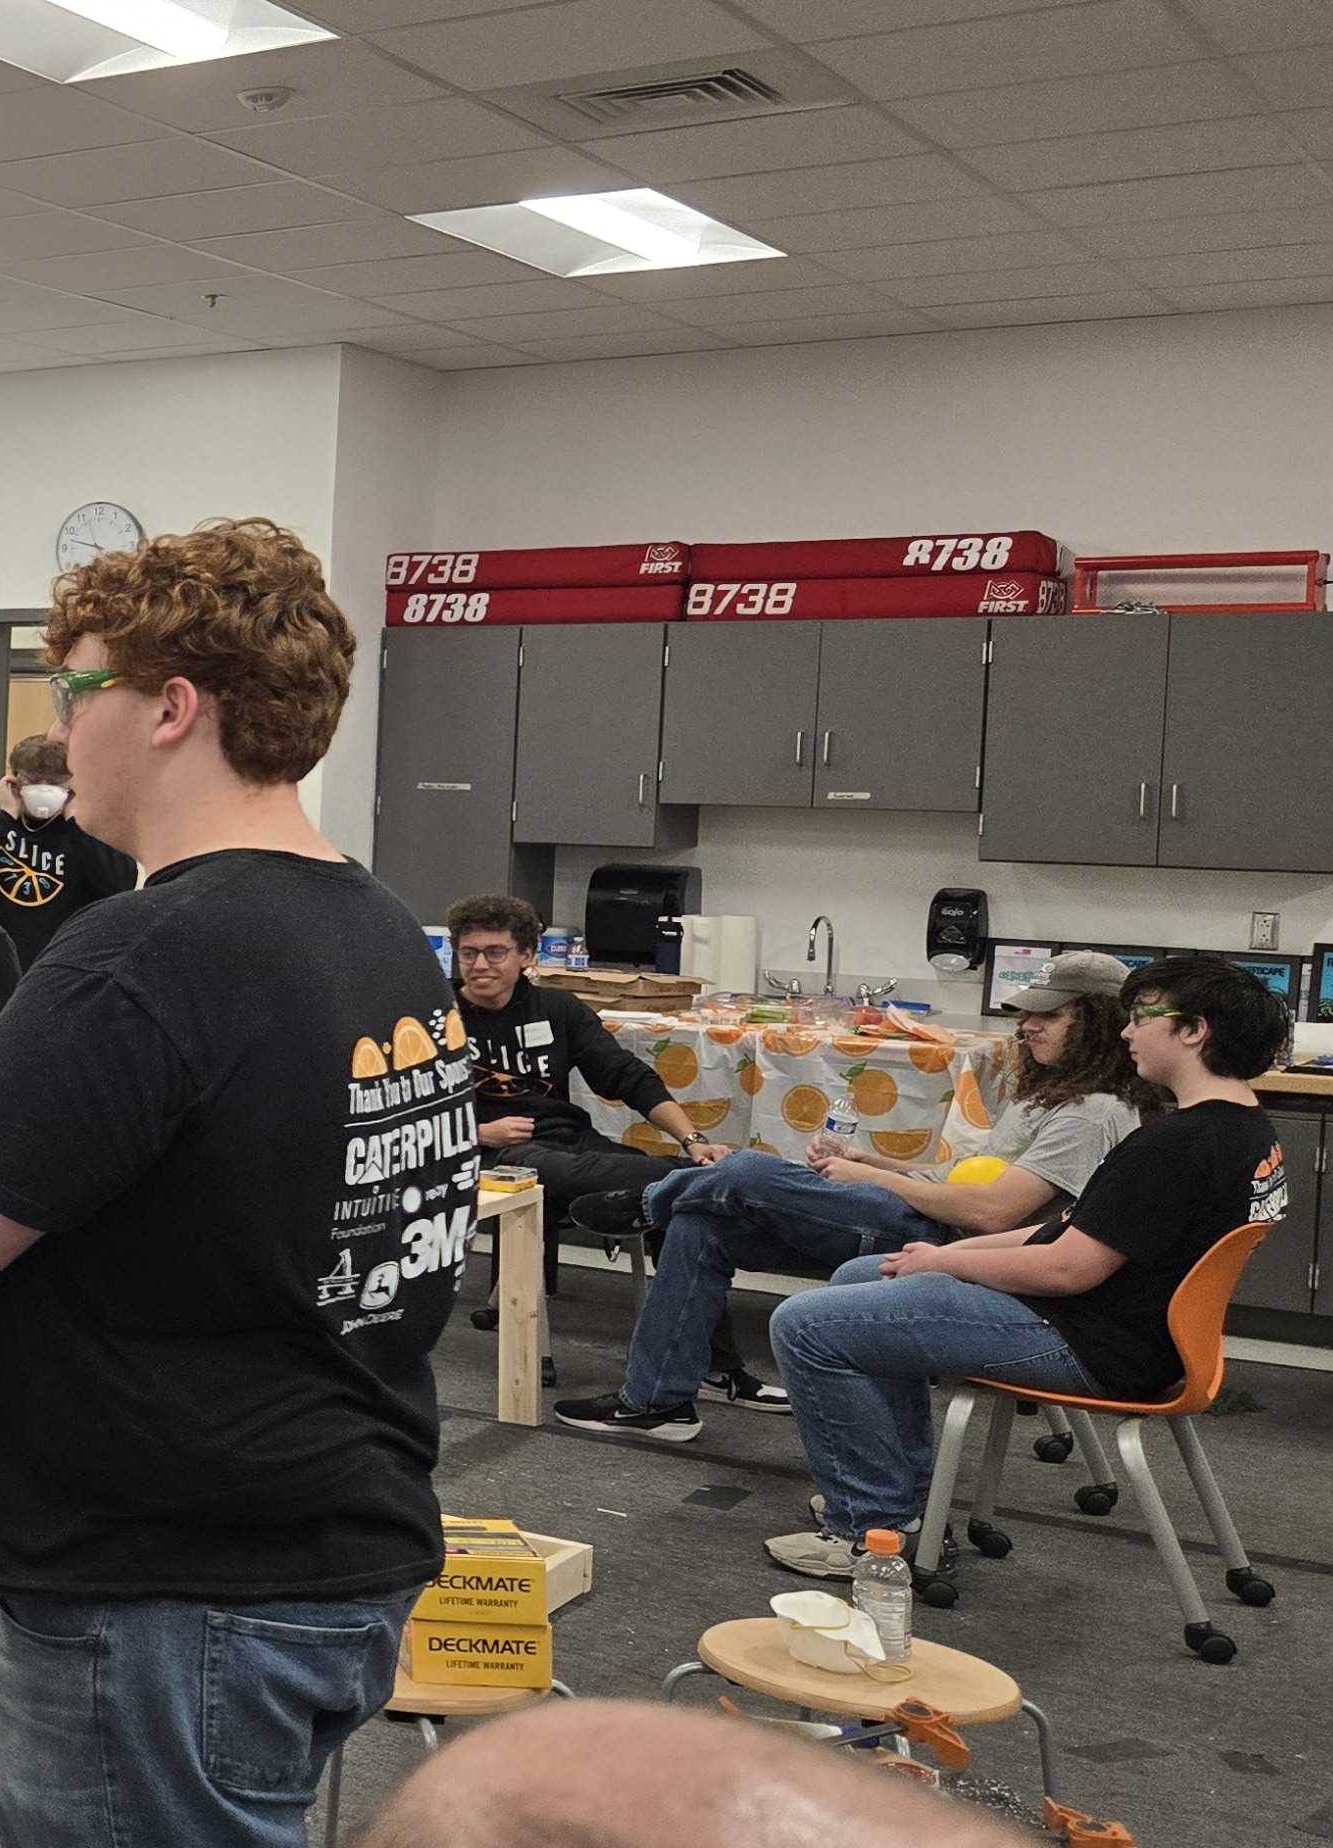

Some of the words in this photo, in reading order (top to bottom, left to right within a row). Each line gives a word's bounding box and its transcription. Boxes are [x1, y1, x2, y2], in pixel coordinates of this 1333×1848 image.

[639, 561, 682, 574] FIRST
[903, 536, 1013, 571] 8738
[386, 554, 479, 585] 8738
[403, 593, 490, 623] 8738
[686, 583, 796, 615] 8738
[978, 600, 1028, 614] FIRST
[5, 830, 65, 876] SLICE
[467, 1036, 551, 1078] SLICE
[344, 1101, 478, 1185] CATERPILL
[333, 1187, 401, 1221] INTUITIE
[400, 1204, 471, 1280] 3M
[439, 1596, 475, 1606] LIFETIME
[475, 1598, 518, 1608] WARRANTY
[428, 1636, 538, 1656] DECKMATE
[445, 1660, 482, 1670] LIFETIME
[482, 1661, 525, 1672] WARRANTY
